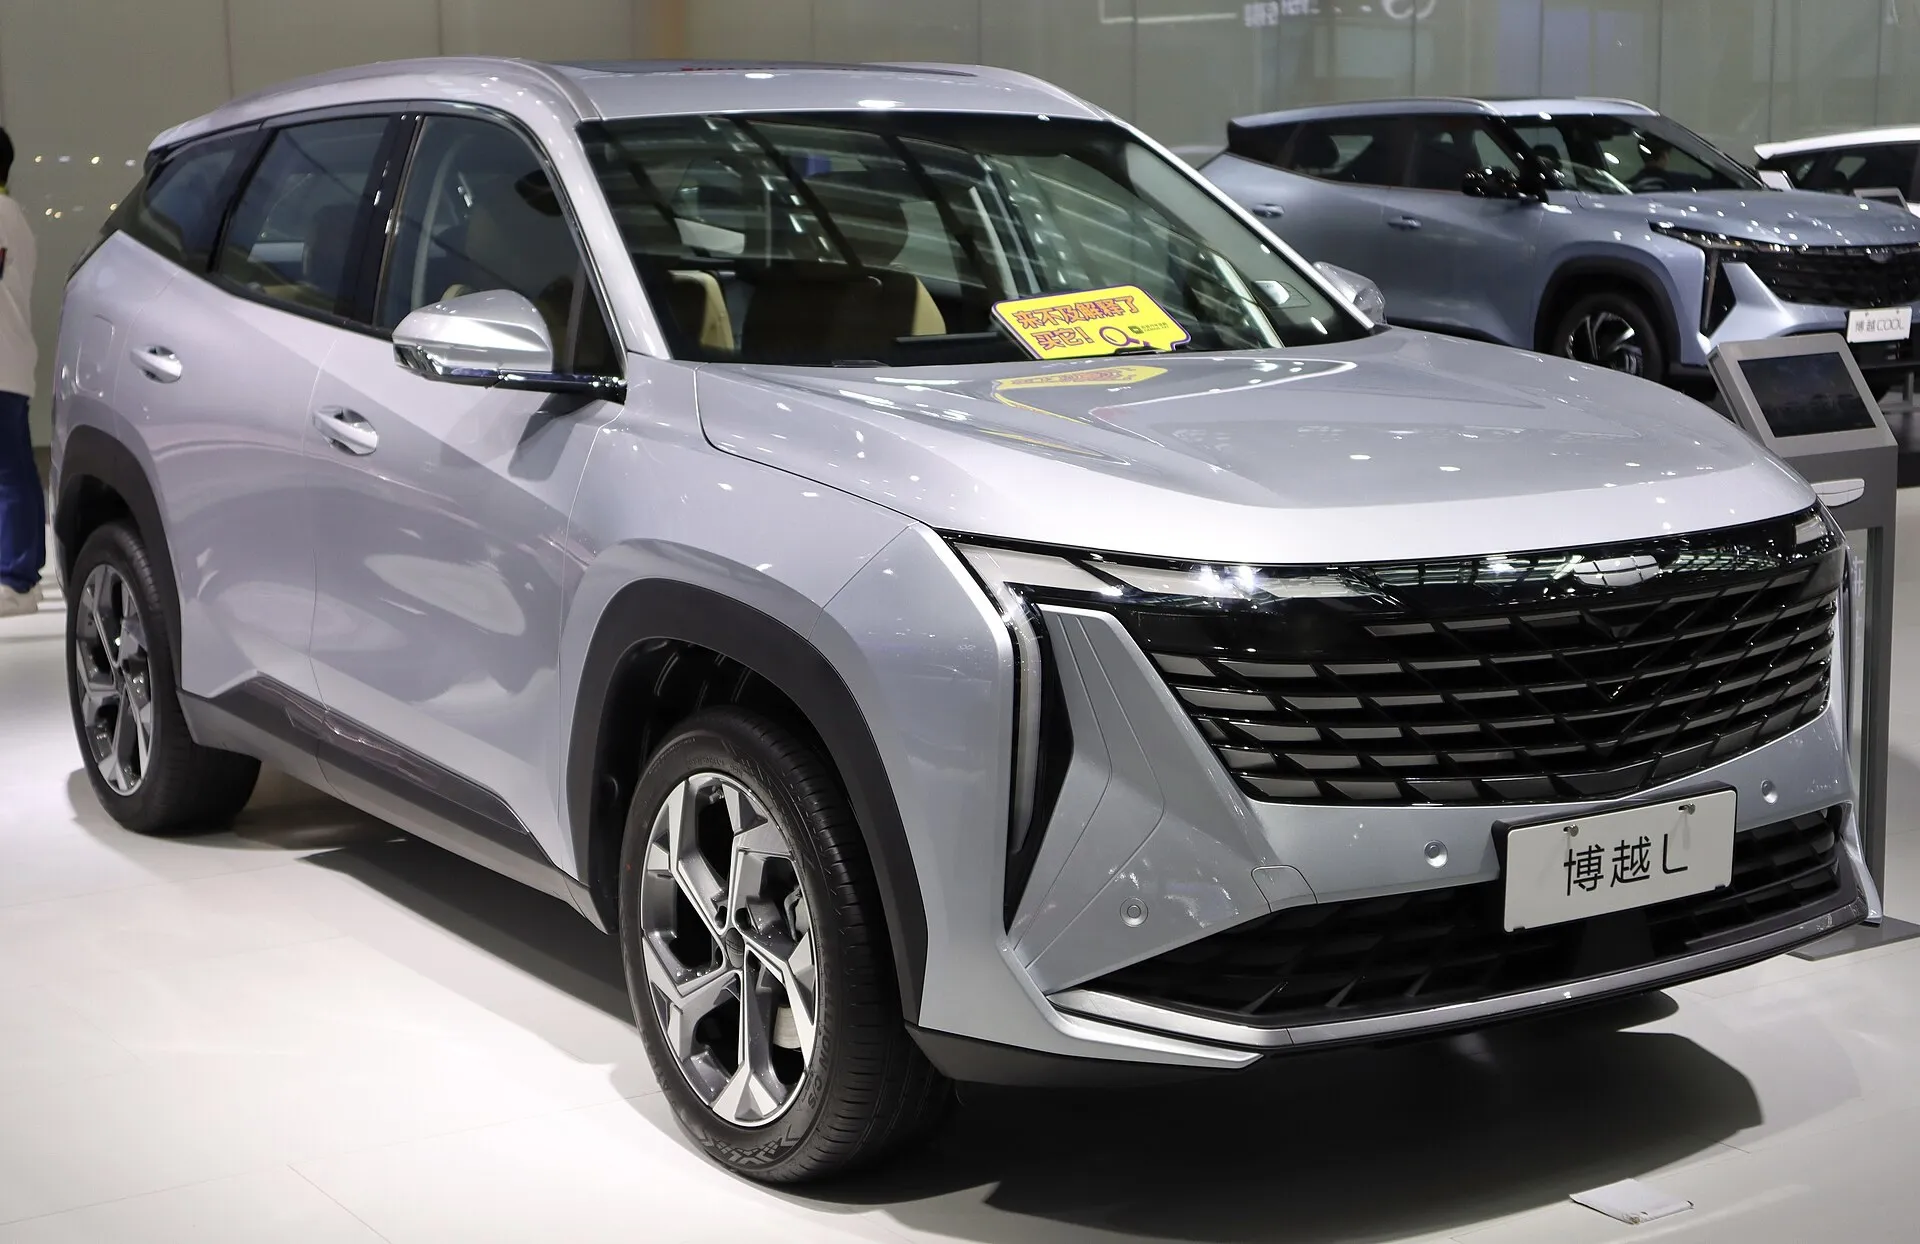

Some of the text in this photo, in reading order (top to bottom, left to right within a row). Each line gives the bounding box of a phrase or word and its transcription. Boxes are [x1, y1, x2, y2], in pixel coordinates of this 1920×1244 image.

[1012, 296, 1139, 329] 来不及解释了
